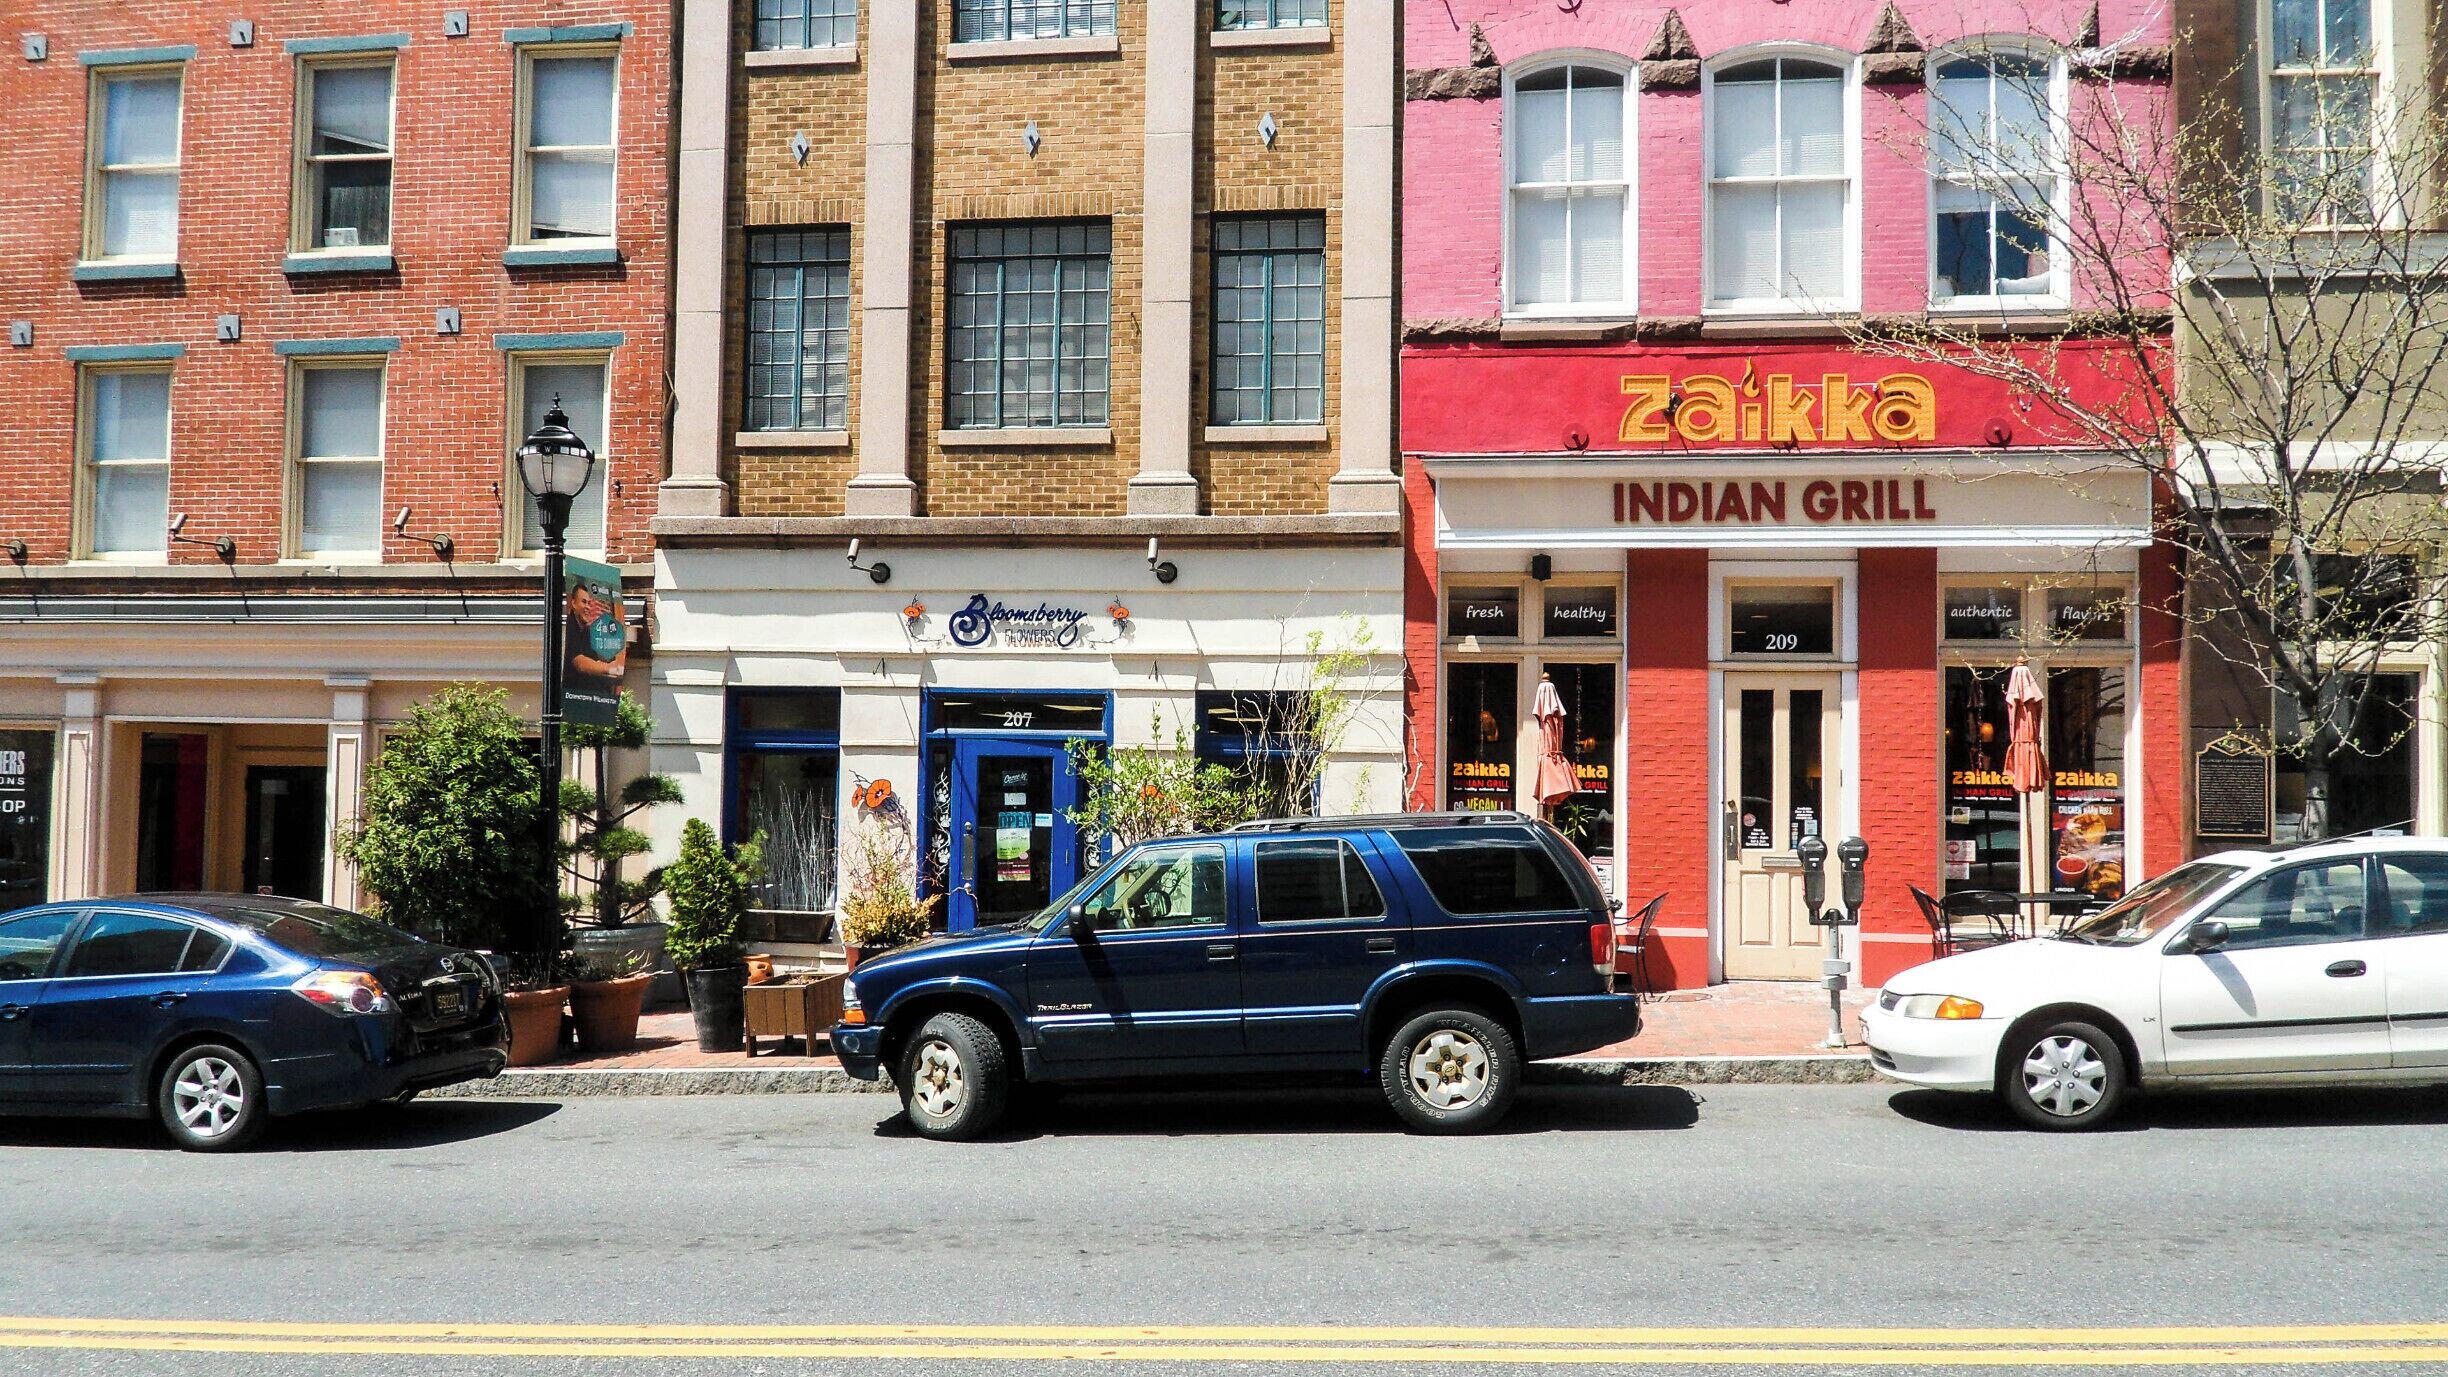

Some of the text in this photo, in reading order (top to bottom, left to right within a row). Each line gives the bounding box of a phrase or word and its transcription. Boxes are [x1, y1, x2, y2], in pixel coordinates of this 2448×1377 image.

[1618, 359, 1936, 442] zaikka
[1613, 479, 1937, 522] INDIAN GRILL
[1466, 605, 1504, 619] fresh
[1553, 606, 1606, 622] healthy
[1950, 604, 2013, 618] authentic
[2062, 605, 2111, 621] flavrs
[949, 593, 1088, 648] Bloomsberry
[1004, 629, 1056, 642] FLOWERS
[1765, 634, 1798, 650] 209
[1003, 711, 1033, 727] 207
[1453, 761, 1510, 777] zaikka
[1952, 769, 2014, 785] zaikka
[1486, 780, 1510, 788] GRILL
[1585, 781, 1608, 790] GRILL
[2055, 769, 2118, 786] zaikka
[0, 800, 26, 813] OP
[999, 812, 1032, 829] OPEN
